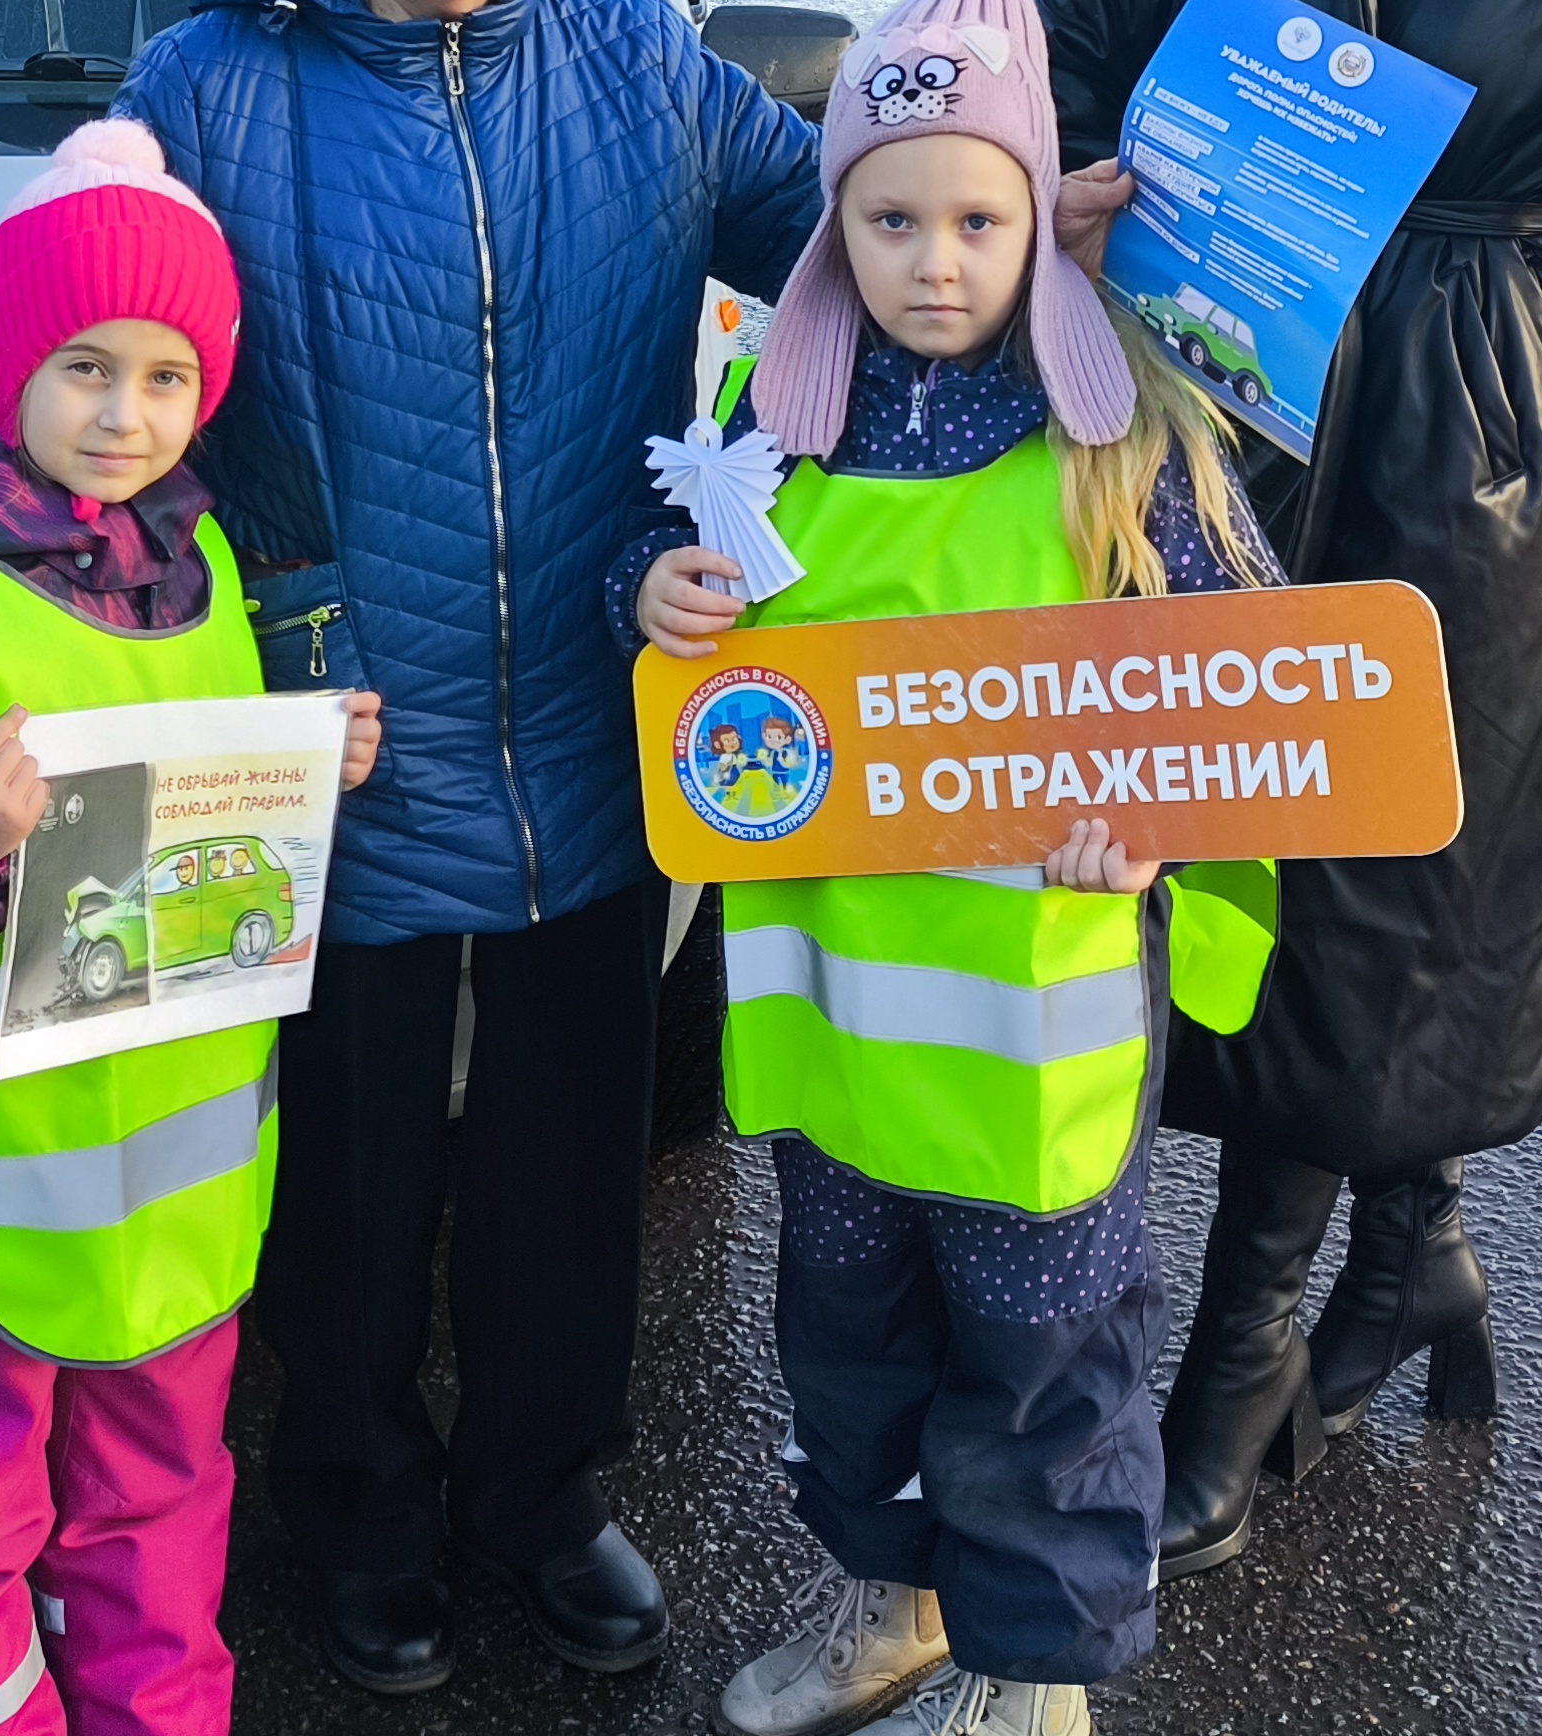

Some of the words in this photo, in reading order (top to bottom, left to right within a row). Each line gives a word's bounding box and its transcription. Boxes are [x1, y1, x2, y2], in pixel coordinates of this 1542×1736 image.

[1221, 45, 1309, 97] УВАЖАЕМЫЙ
[1308, 90, 1385, 136] ВОДИТЕЛЬ!
[752, 668, 762, 680] В
[856, 642, 1393, 729] БЕЗОПАСНОСТЬ
[155, 777, 174, 795] НЕ
[177, 770, 240, 791] ОБРЫВАЙ
[244, 767, 307, 786] ЖИЗНЬ!
[865, 762, 906, 817] В
[921, 739, 1332, 814] ОТРАЖЕНИИ
[155, 796, 234, 820] СОБЛЮДАЙ
[765, 826, 777, 839] В
